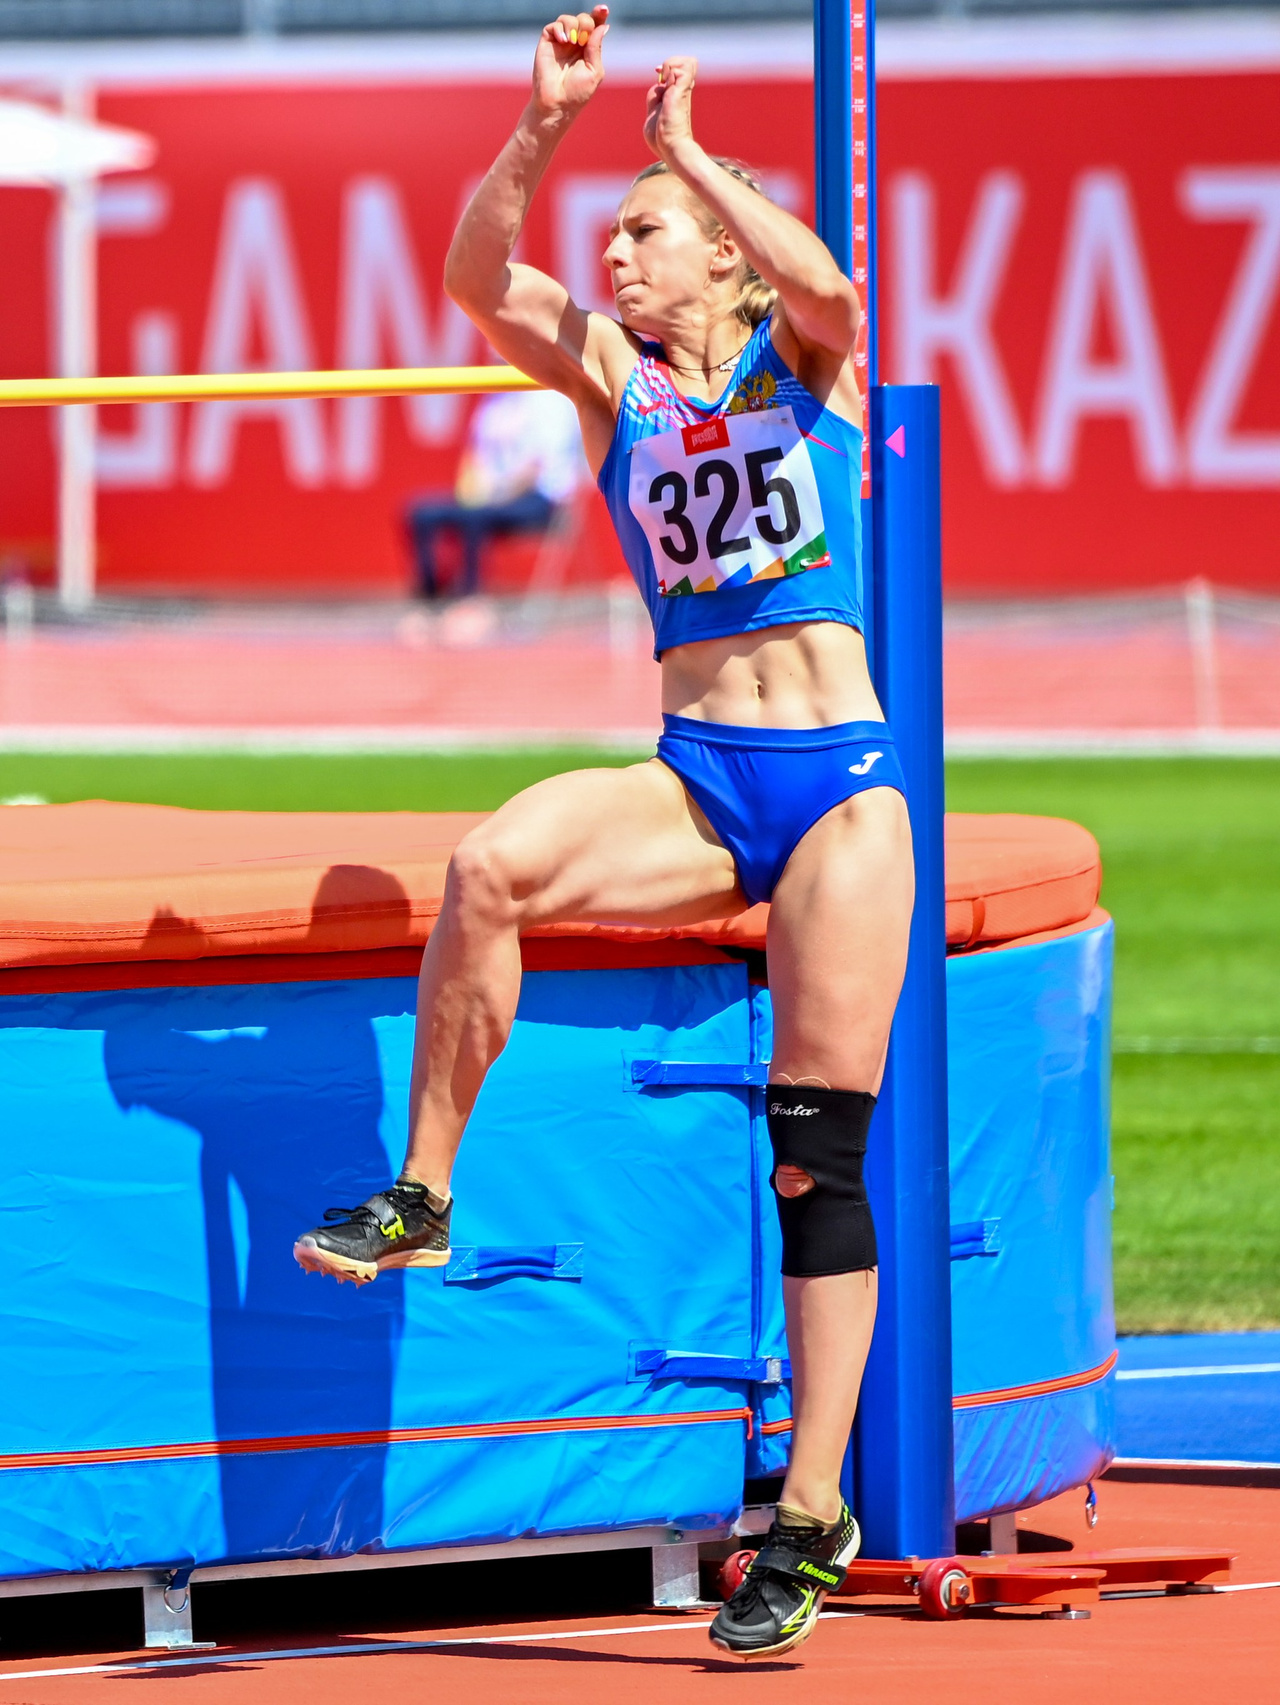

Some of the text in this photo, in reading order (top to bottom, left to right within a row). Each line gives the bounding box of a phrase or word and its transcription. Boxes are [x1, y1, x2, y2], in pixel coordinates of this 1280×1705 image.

[55, 180, 806, 490] GAM
[648, 446, 801, 565] 325
[770, 1103, 813, 1116] Fosta
